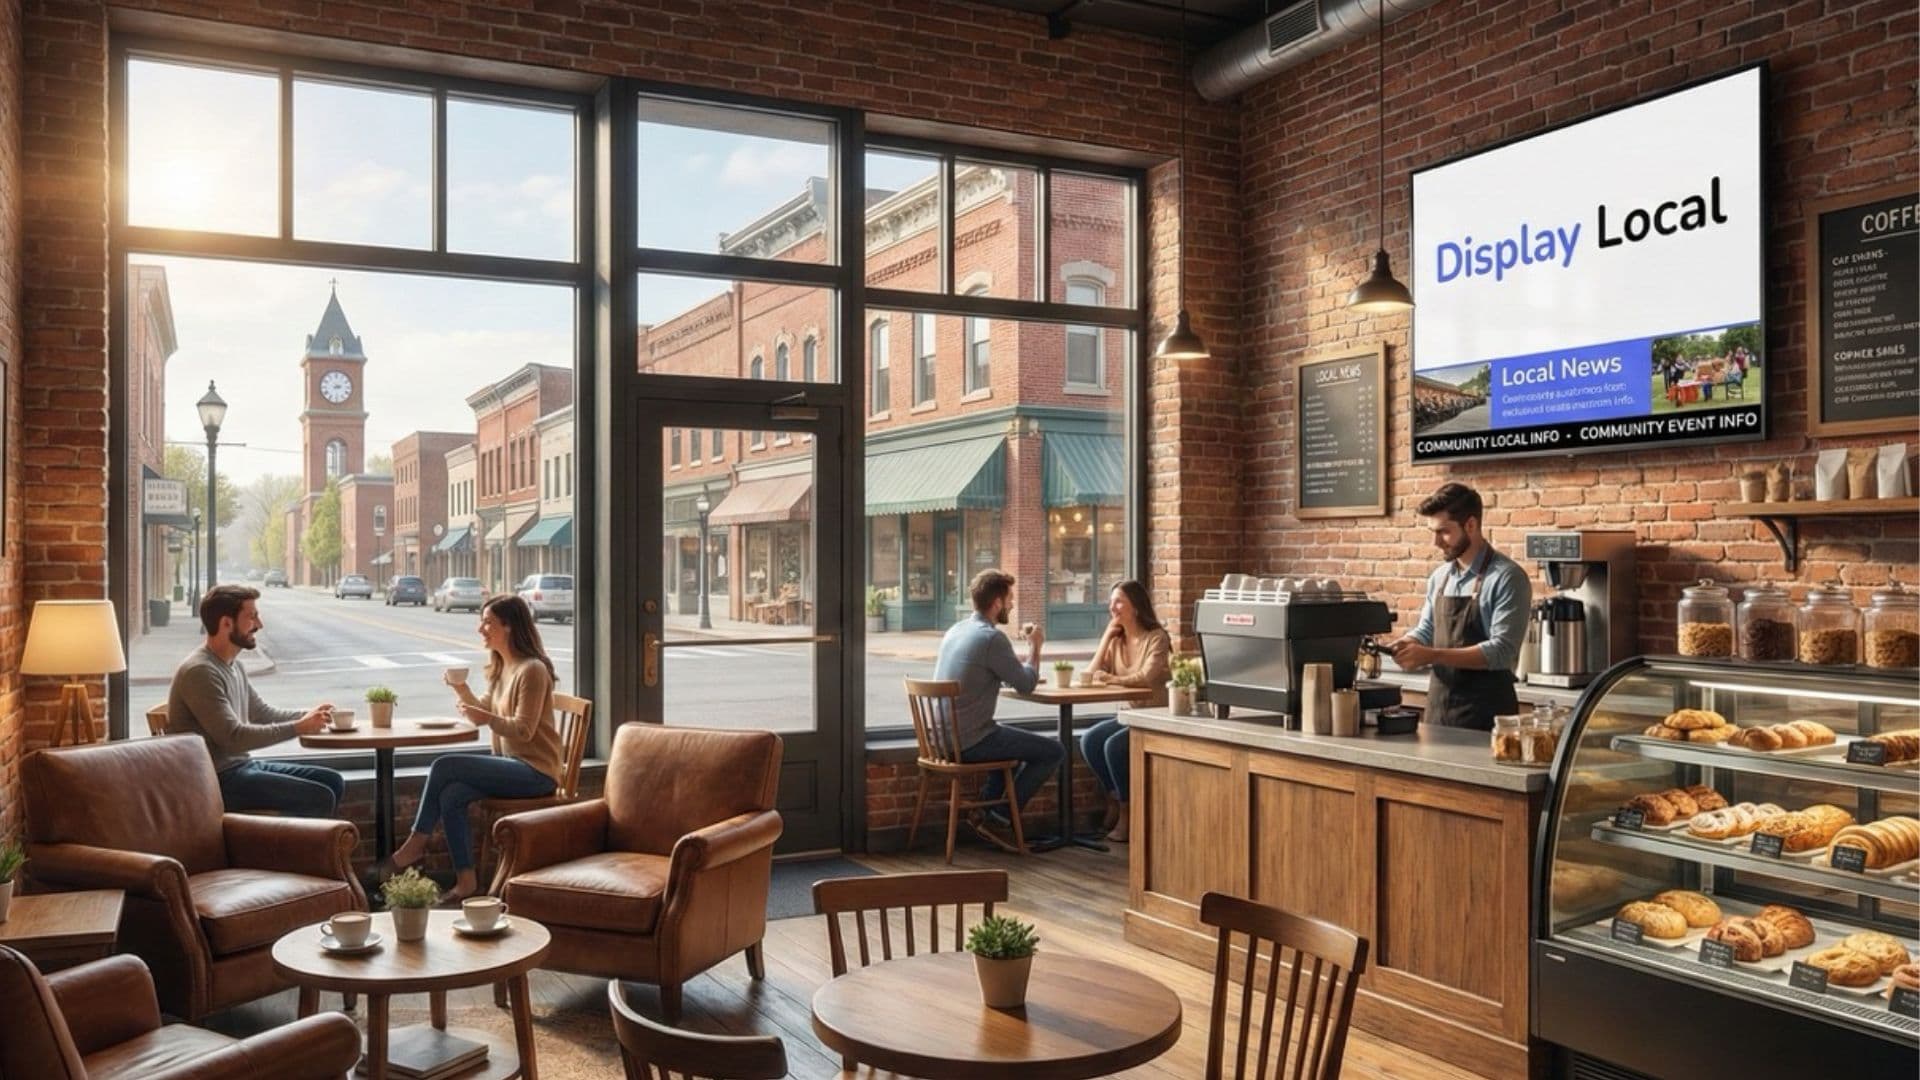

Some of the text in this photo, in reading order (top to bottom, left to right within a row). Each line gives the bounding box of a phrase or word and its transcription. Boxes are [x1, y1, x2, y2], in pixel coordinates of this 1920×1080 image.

[1437, 176, 1728, 283] Display Local
[1502, 357, 1622, 387] Local News
[1416, 412, 1757, 453] COMMUNITY LOCAL INFO COMMUNITY EVENT INFO
